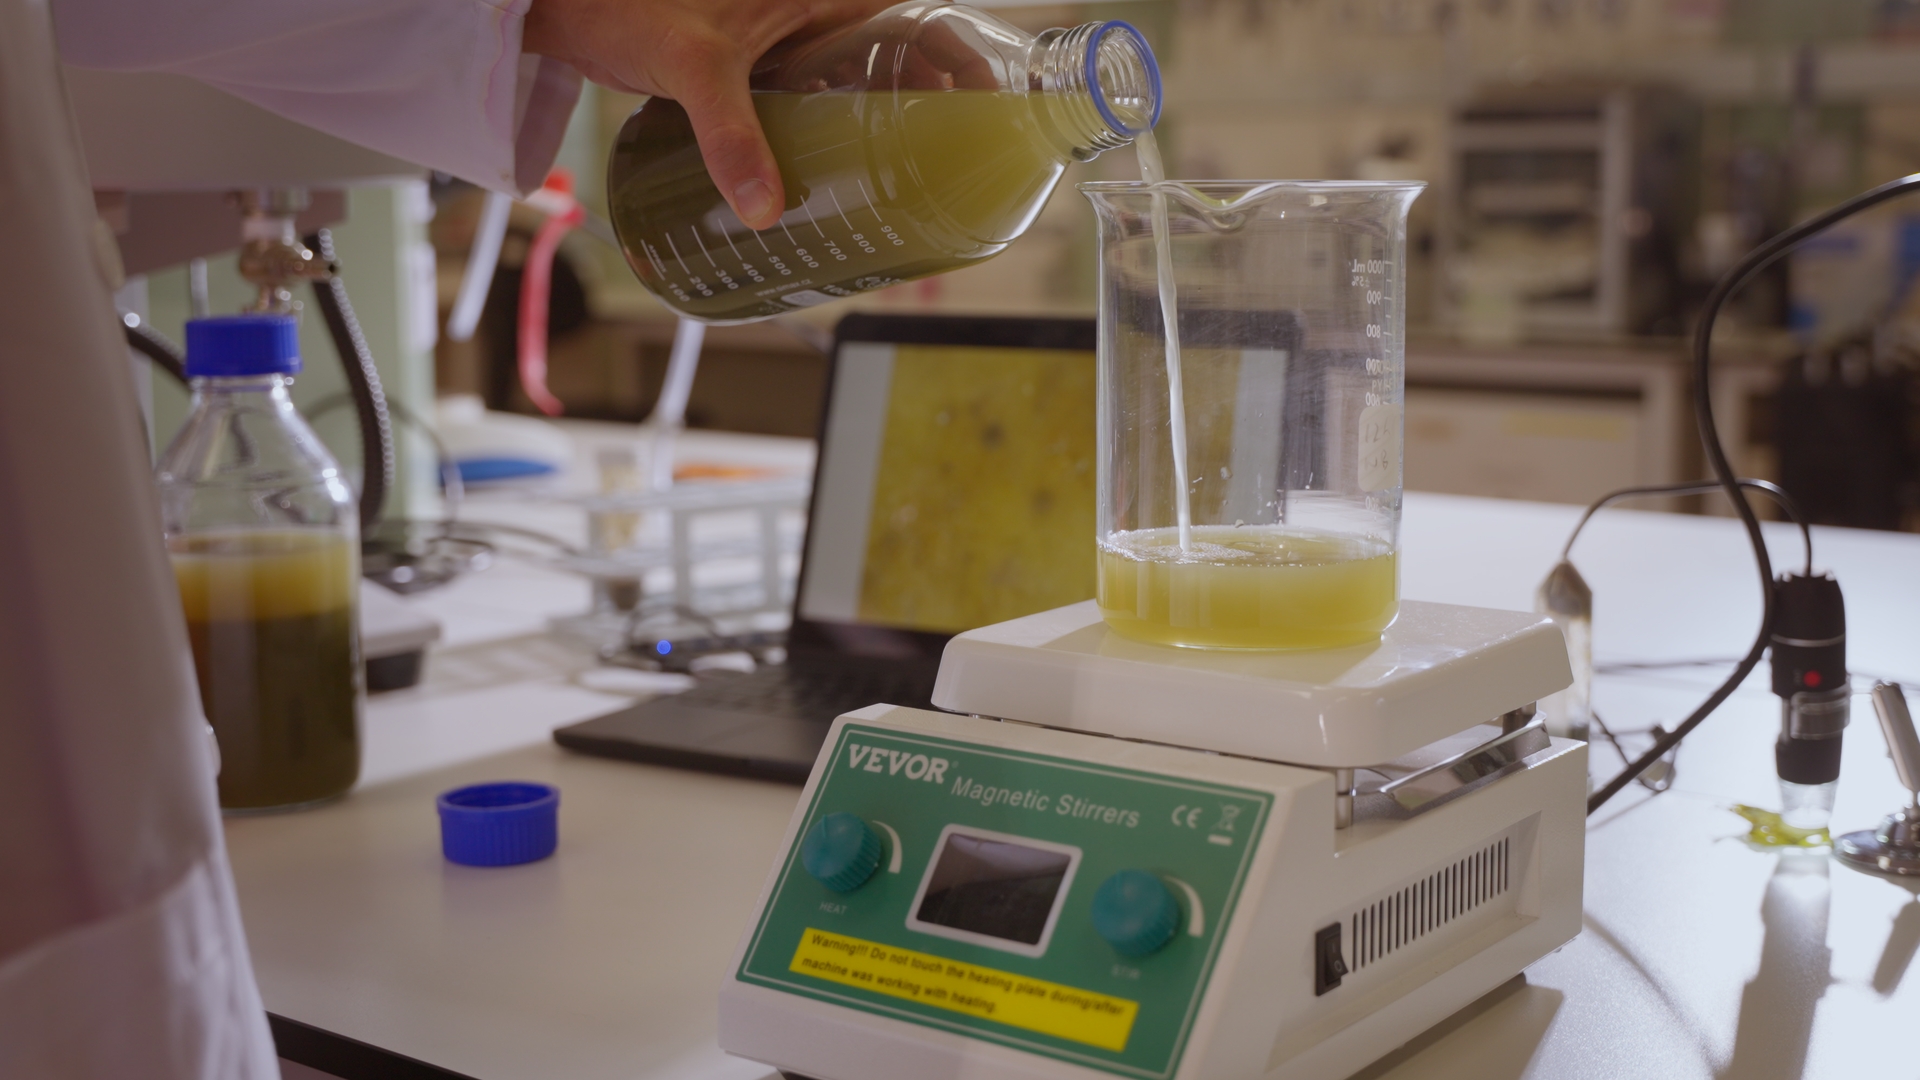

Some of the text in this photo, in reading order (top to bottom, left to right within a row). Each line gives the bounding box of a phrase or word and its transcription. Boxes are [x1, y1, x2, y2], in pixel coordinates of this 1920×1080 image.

[852, 233, 876, 254] 800
[881, 225, 904, 246] 900
[796, 248, 819, 268] 600
[824, 240, 847, 261] 700
[742, 262, 765, 283] 400
[768, 255, 792, 276] 500
[689, 276, 713, 297] 200
[715, 269, 739, 290] 300
[668, 282, 691, 302] 100
[849, 743, 950, 785] VEVOR
[951, 775, 1141, 828] Magnetic Stirrers
[819, 901, 848, 915] HEAT
[811, 933, 869, 956] Warning!!!
[870, 947, 887, 961] Do
[889, 954, 909, 967] not
[911, 957, 943, 974] touch
[946, 964, 964, 979] the
[967, 970, 1014, 993] heating
[1014, 981, 1048, 998] plate
[801, 956, 849, 977] machine
[851, 968, 874, 983] was
[876, 974, 922, 997] working
[924, 984, 948, 999] with
